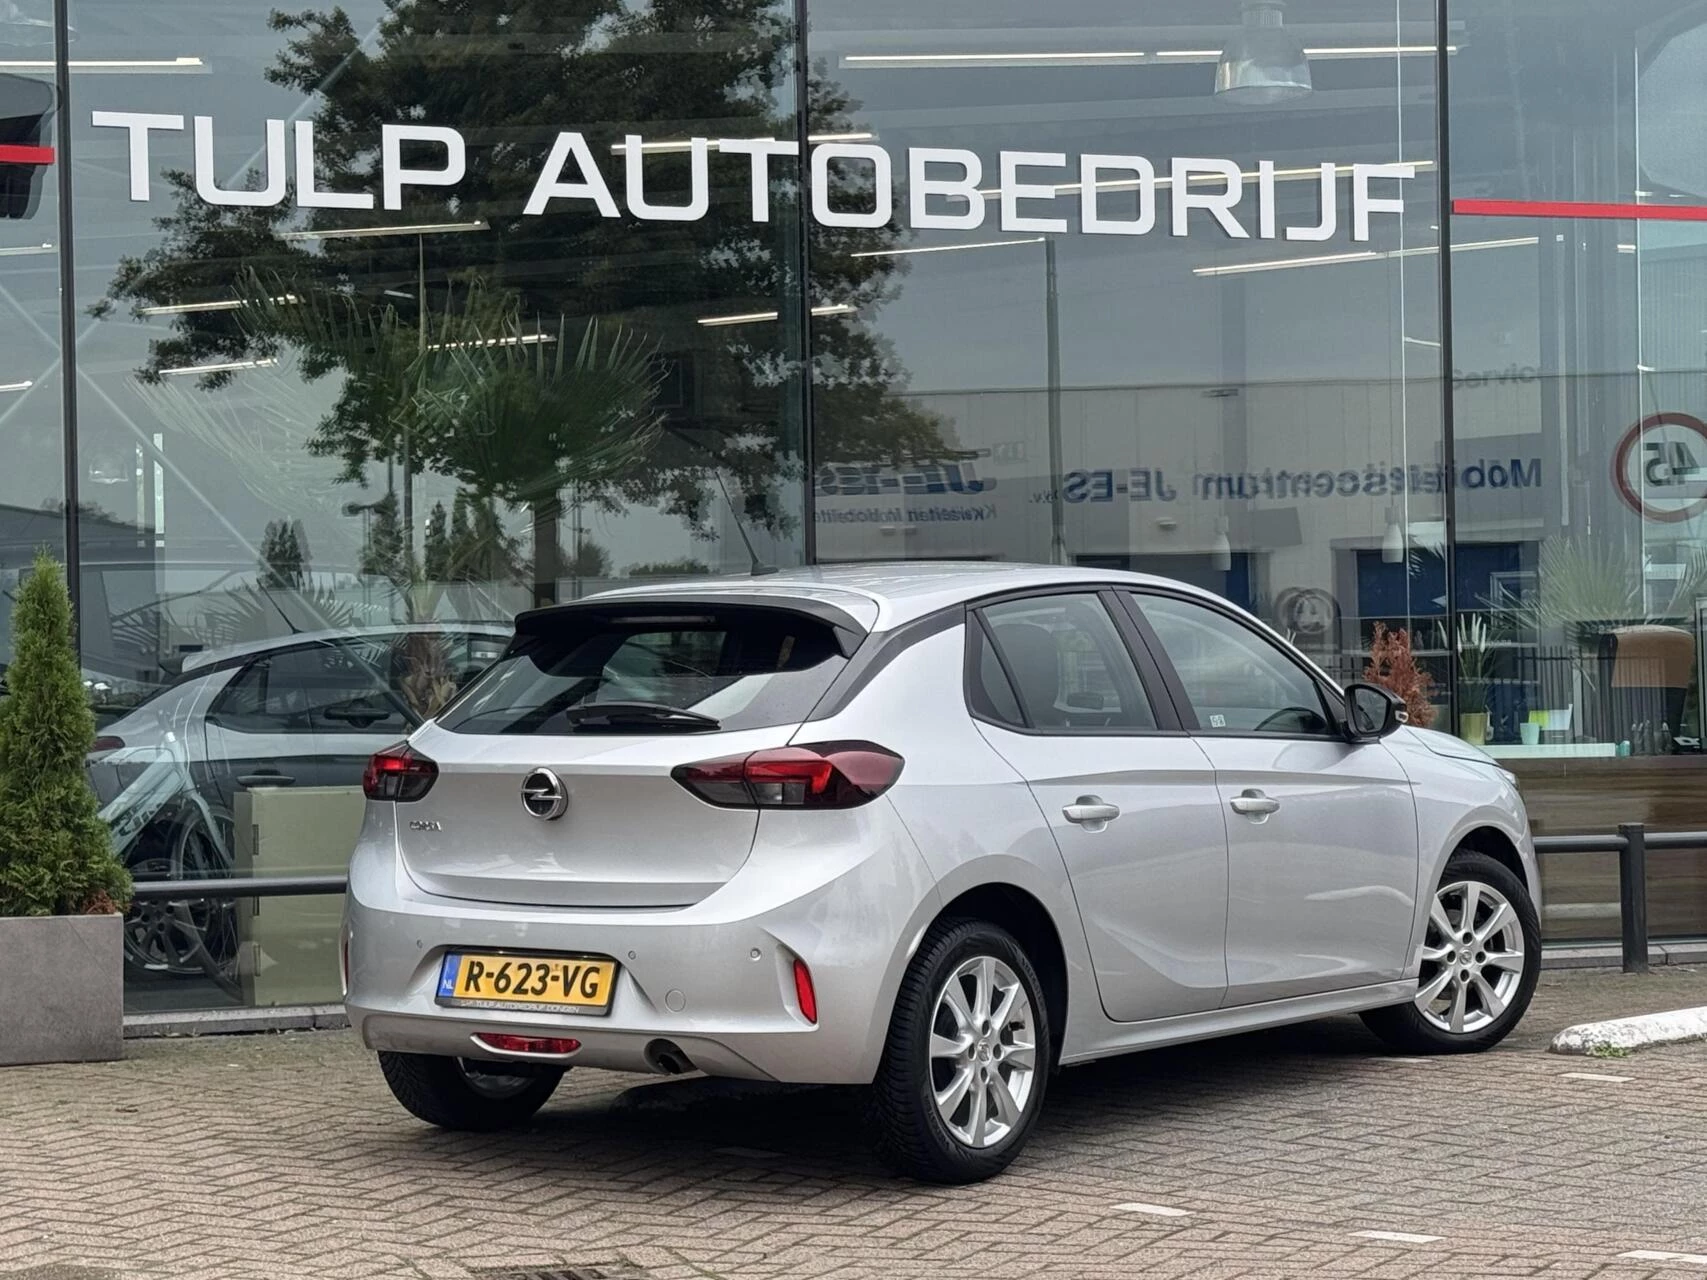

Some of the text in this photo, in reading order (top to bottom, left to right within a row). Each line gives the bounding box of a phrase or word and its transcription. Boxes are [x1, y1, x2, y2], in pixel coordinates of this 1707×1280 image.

[92, 110, 1415, 241] TULP AUTOBEDRIJF
[441, 979, 454, 990] NL
[464, 960, 600, 999] R-623-VG
